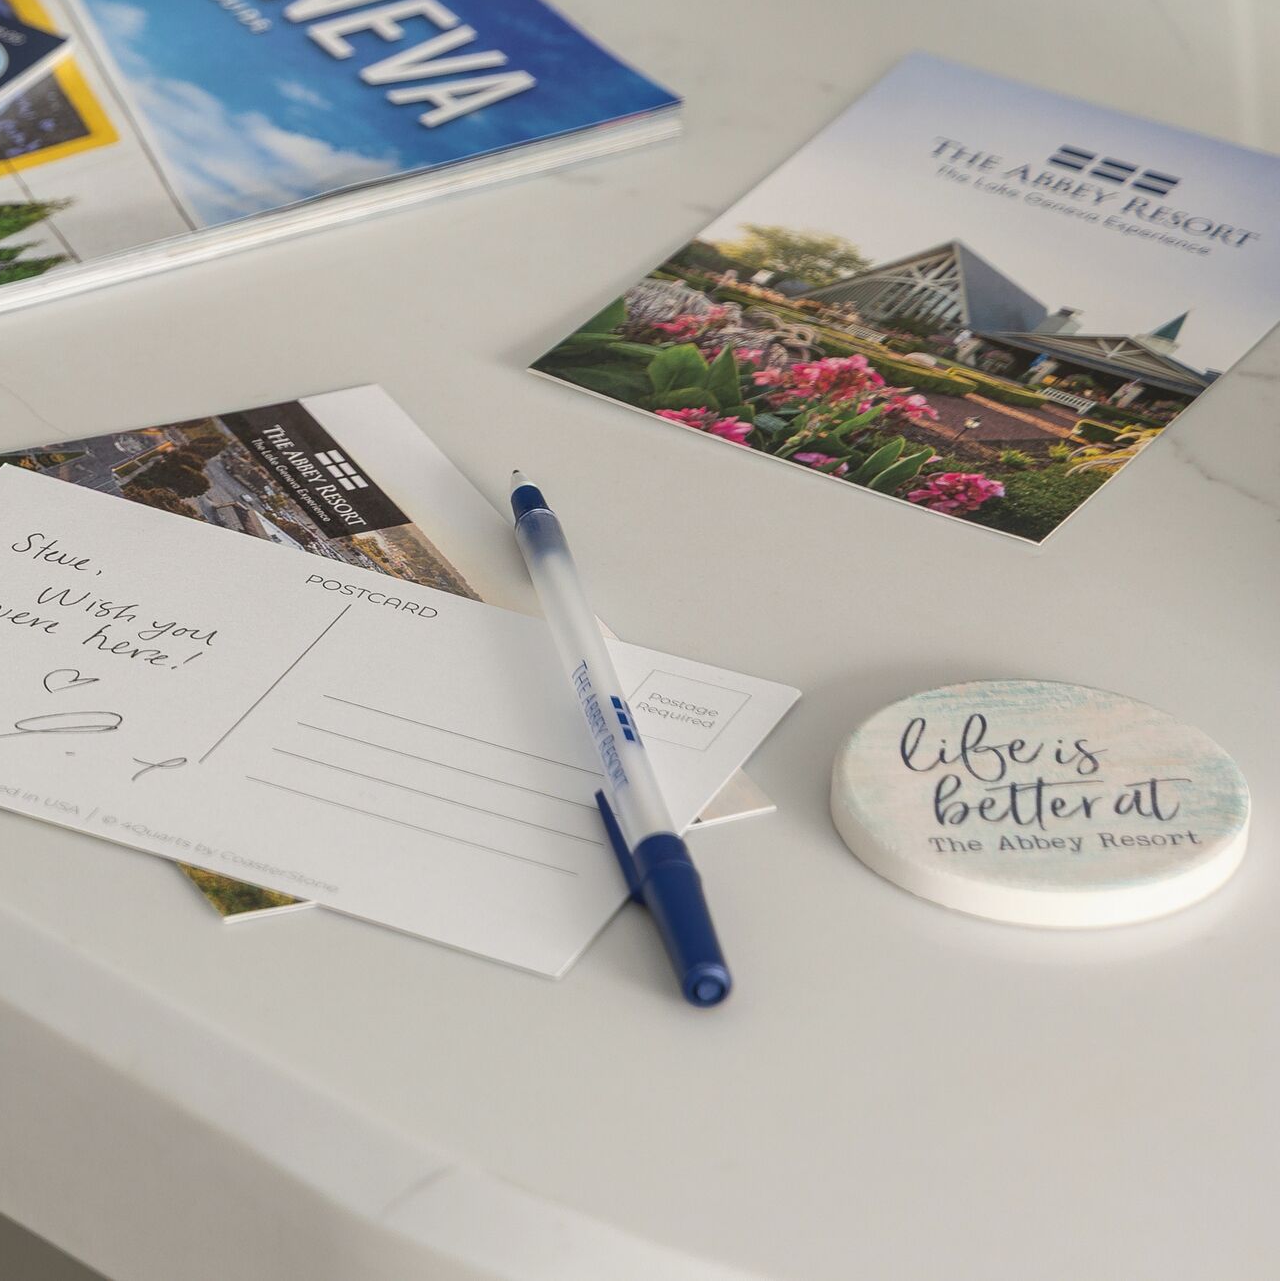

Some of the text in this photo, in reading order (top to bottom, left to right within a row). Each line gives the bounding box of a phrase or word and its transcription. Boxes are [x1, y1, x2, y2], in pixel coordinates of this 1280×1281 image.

[930, 136, 1261, 248] THE ABBEY RESORT
[935, 164, 1213, 258] The Lake Geneva Experience
[251, 438, 332, 523] The Lake Geneva Experience
[262, 424, 367, 526] THE ABBEY RESORT
[37, 586, 218, 646] Wish you
[305, 574, 438, 618] POSTCARD
[82, 625, 203, 670] here!
[571, 659, 630, 790] THE ABBEY RESORT
[636, 701, 716, 729] Required
[648, 692, 720, 717] Postage
[900, 713, 1108, 782] life is
[934, 774, 1192, 831] better at
[22, 790, 40, 802] in
[44, 796, 80, 815] USA
[194, 842, 218, 857] by
[220, 850, 340, 893] CoasterStone
[928, 829, 1203, 854] The Abbey Resort
